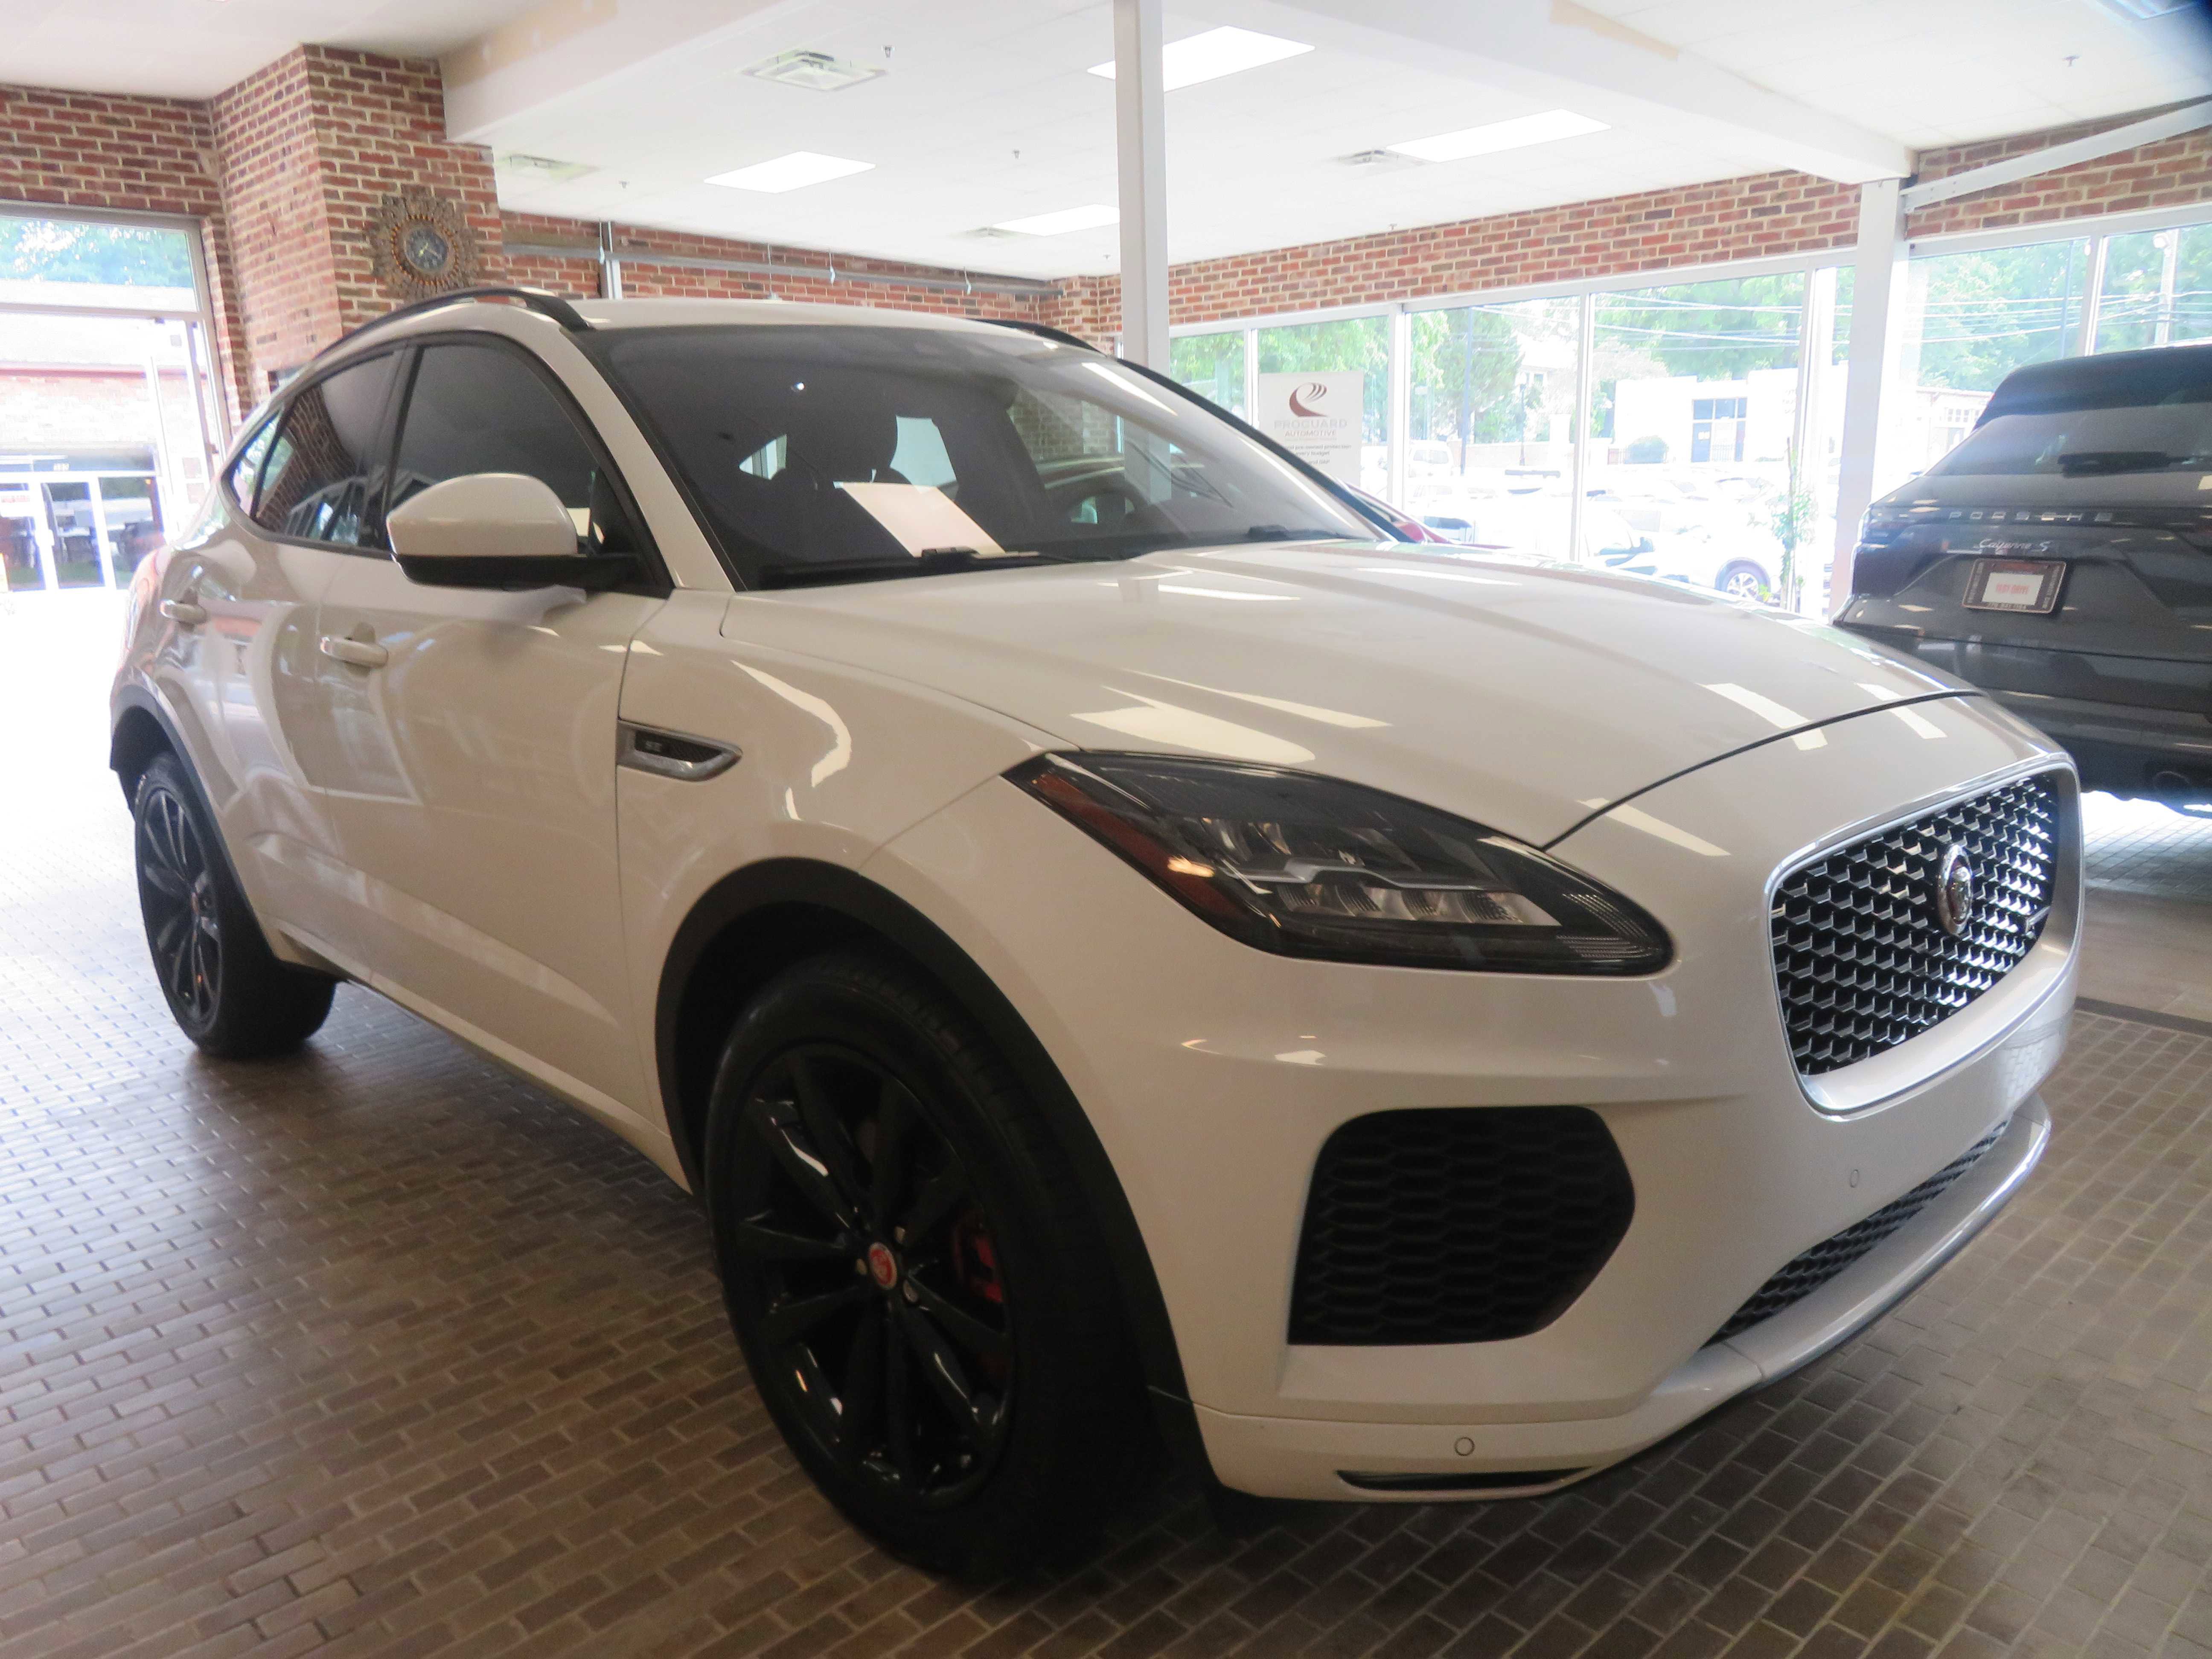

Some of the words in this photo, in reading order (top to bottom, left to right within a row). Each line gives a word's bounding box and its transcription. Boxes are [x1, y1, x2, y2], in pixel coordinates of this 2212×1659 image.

[1284, 429, 1336, 437] AUTOMOTIVE
[1949, 511, 2113, 522] PORSCHE
[1978, 538, 2032, 551] Cayenne
[2038, 540, 2052, 552] S
